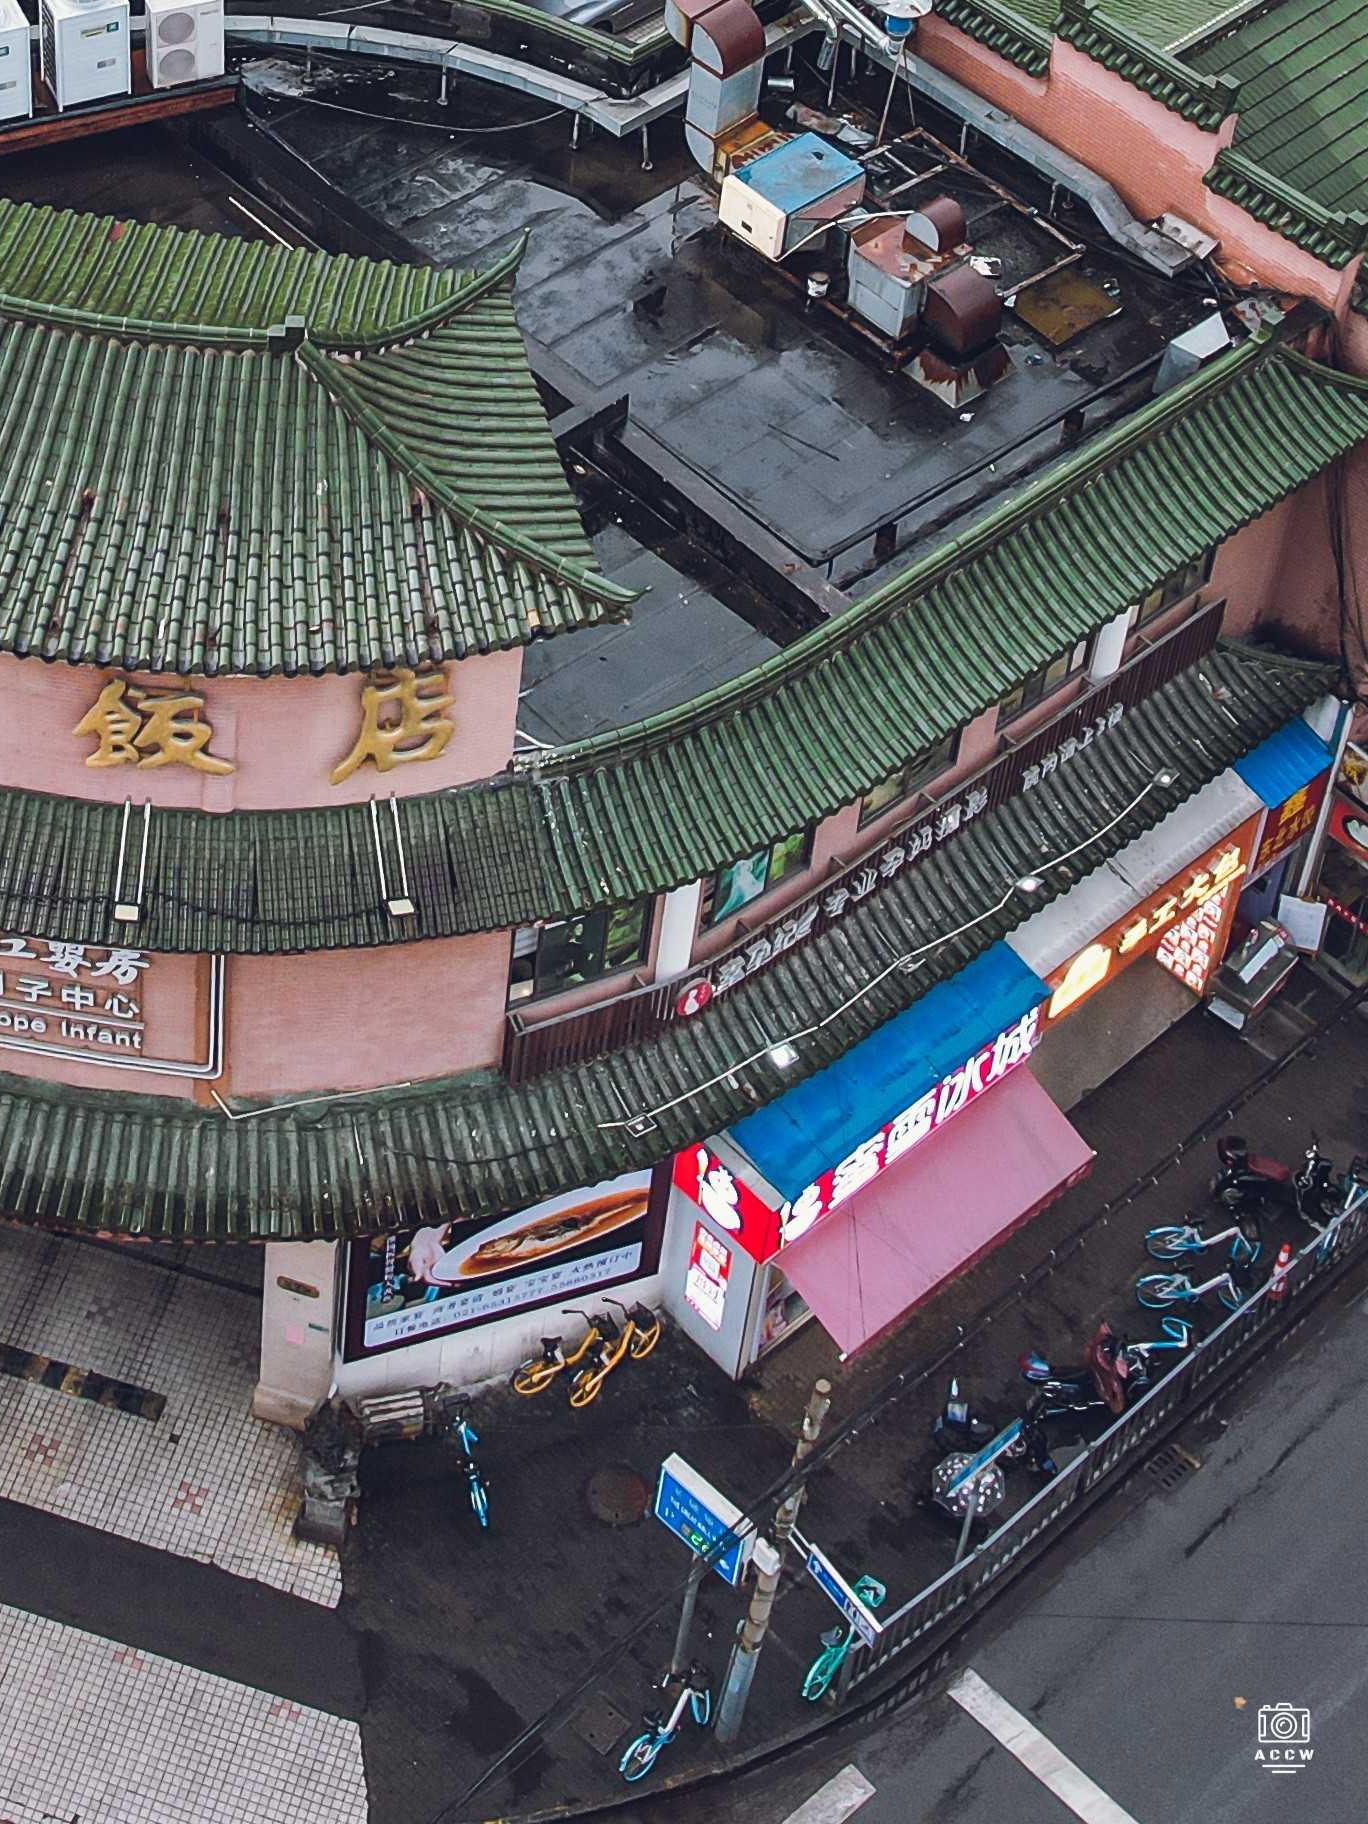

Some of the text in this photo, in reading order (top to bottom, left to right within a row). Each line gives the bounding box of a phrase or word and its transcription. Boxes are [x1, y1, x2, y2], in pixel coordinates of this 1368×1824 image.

[60, 1019, 143, 1050] Infant
[828, 1006, 1040, 1210] 蜜雪冰城
